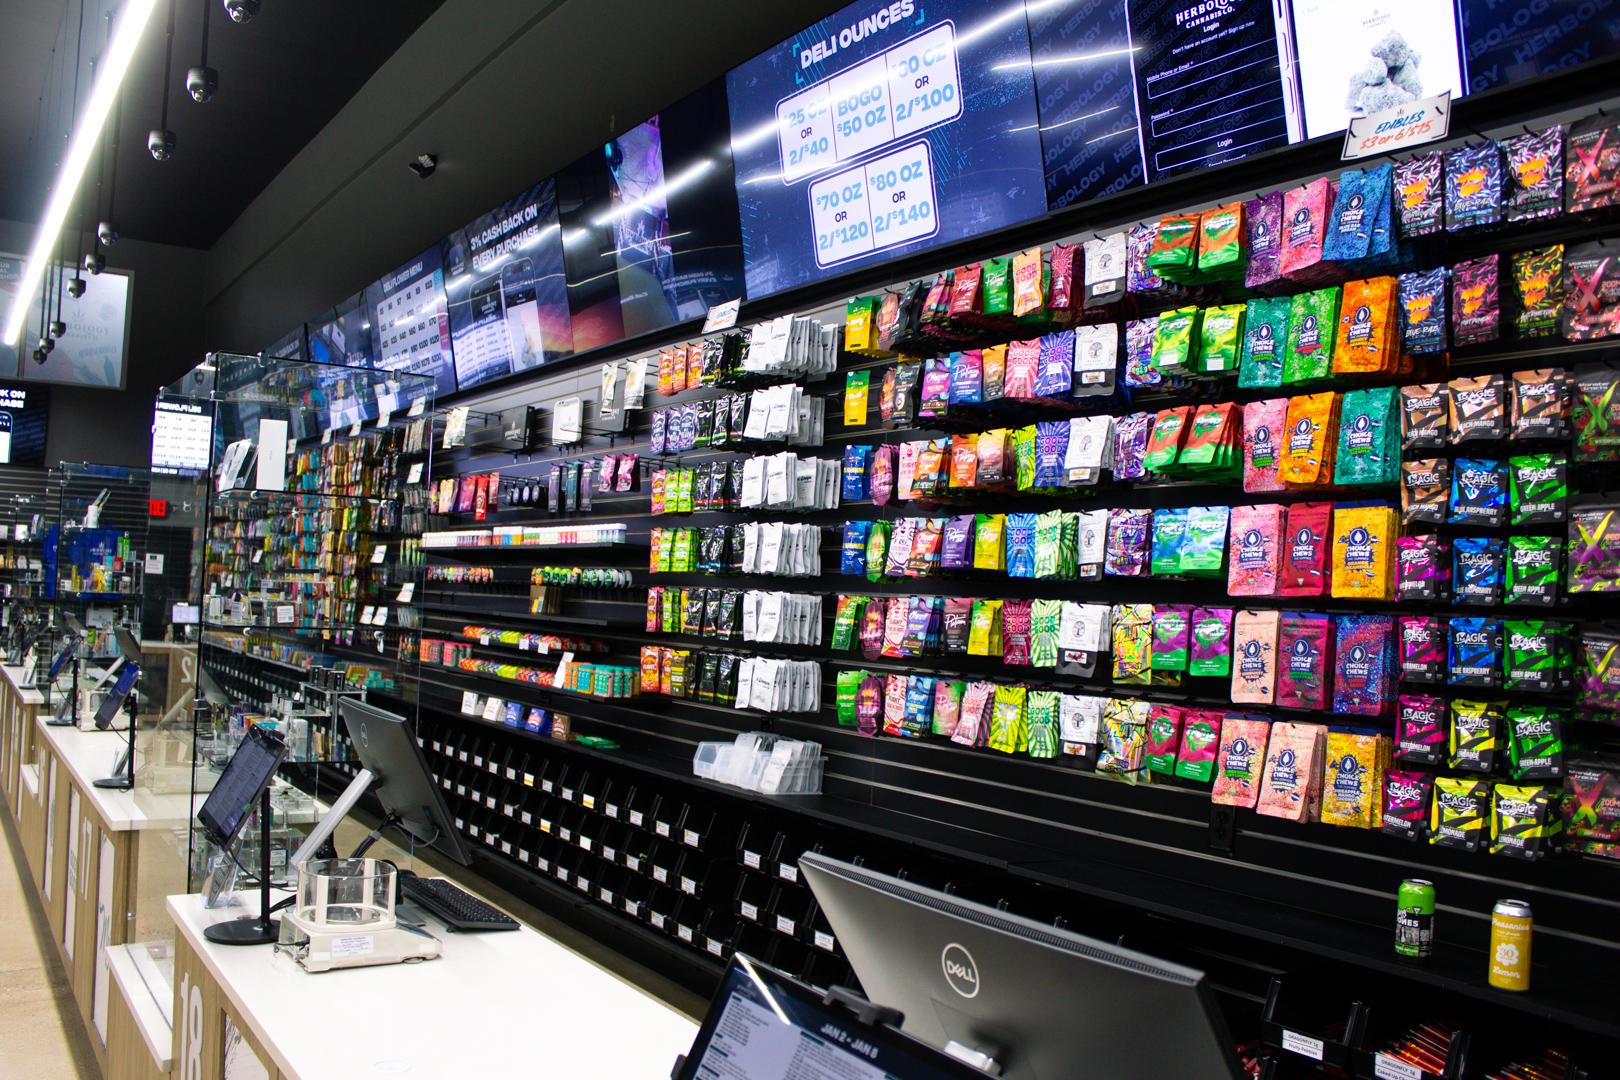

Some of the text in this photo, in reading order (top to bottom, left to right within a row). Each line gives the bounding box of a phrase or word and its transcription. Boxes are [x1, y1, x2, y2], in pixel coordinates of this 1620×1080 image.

[1176, 0, 1242, 25] HERBOLO
[1186, 7, 1235, 29] CANNABIS CO.
[1203, 22, 1220, 32] Login
[801, 0, 915, 69] DELI OUNCES
[1172, 46, 1184, 54] Don't
[1184, 42, 1194, 50] have
[1201, 34, 1218, 44] account
[1218, 30, 1228, 40] yet?
[1228, 26, 1238, 34] Sign
[1160, 70, 1173, 78] Phone
[1179, 63, 1190, 71] Email
[914, 76, 929, 89] OR
[838, 84, 882, 116] BOGO
[896, 84, 954, 122] 2/$100
[784, 108, 805, 129] 25
[837, 105, 886, 138] $50 OZ
[1375, 110, 1424, 134] EDIBLES
[801, 127, 813, 139] OR
[1217, 138, 1232, 148] Login
[1360, 136, 1378, 150] $3
[1378, 132, 1396, 146] or
[789, 137, 829, 166] 2/$40
[870, 160, 923, 191] $80 OZ
[816, 182, 863, 212] $70 OZ
[892, 191, 906, 203] OR
[835, 211, 848, 222] OR
[874, 201, 930, 233] 2/$140
[471, 204, 538, 251] 3% CASH BACK ON
[819, 221, 868, 250] 2/$120
[472, 224, 538, 269] EVERY PURCHASE
[1350, 322, 1371, 331] CHOICE
[1014, 349, 1035, 358] GOOD
[1012, 357, 1034, 366] GOOD
[10, 390, 26, 399] ON
[1476, 419, 1494, 428] MANGO
[1530, 416, 1550, 426] MANGO
[1040, 436, 1063, 444] GOOD
[1040, 444, 1062, 453] GOOD
[1520, 504, 1536, 512] GREEN
[1010, 528, 1033, 536] GOOD
[1010, 536, 1033, 544] GOOD
[1346, 550, 1369, 558] CHEWS
[1459, 553, 1493, 566] MAGIC
[1528, 586, 1544, 594] APPLE
[1006, 616, 1030, 624] GOOD
[1033, 616, 1055, 624] GOOD
[1006, 624, 1030, 632] GOOD
[1454, 632, 1488, 645] MAGIC
[1524, 671, 1542, 679] APPLE
[1402, 708, 1435, 722] MAGIC
[1456, 716, 1490, 730] MAGIC
[1515, 722, 1551, 738] MAGIC
[1520, 758, 1552, 766] GREEN APPLE
[1387, 782, 1420, 800] MAGIC
[1439, 794, 1477, 808] MAGIC
[947, 960, 976, 983] DELL
[180, 972, 204, 1080] 18
[821, 1024, 840, 1039] JAN
[851, 1039, 872, 1056] JAN
[1288, 1034, 1312, 1044] DRAGONFLY
[1382, 1060, 1408, 1072] DRAGONFLY
